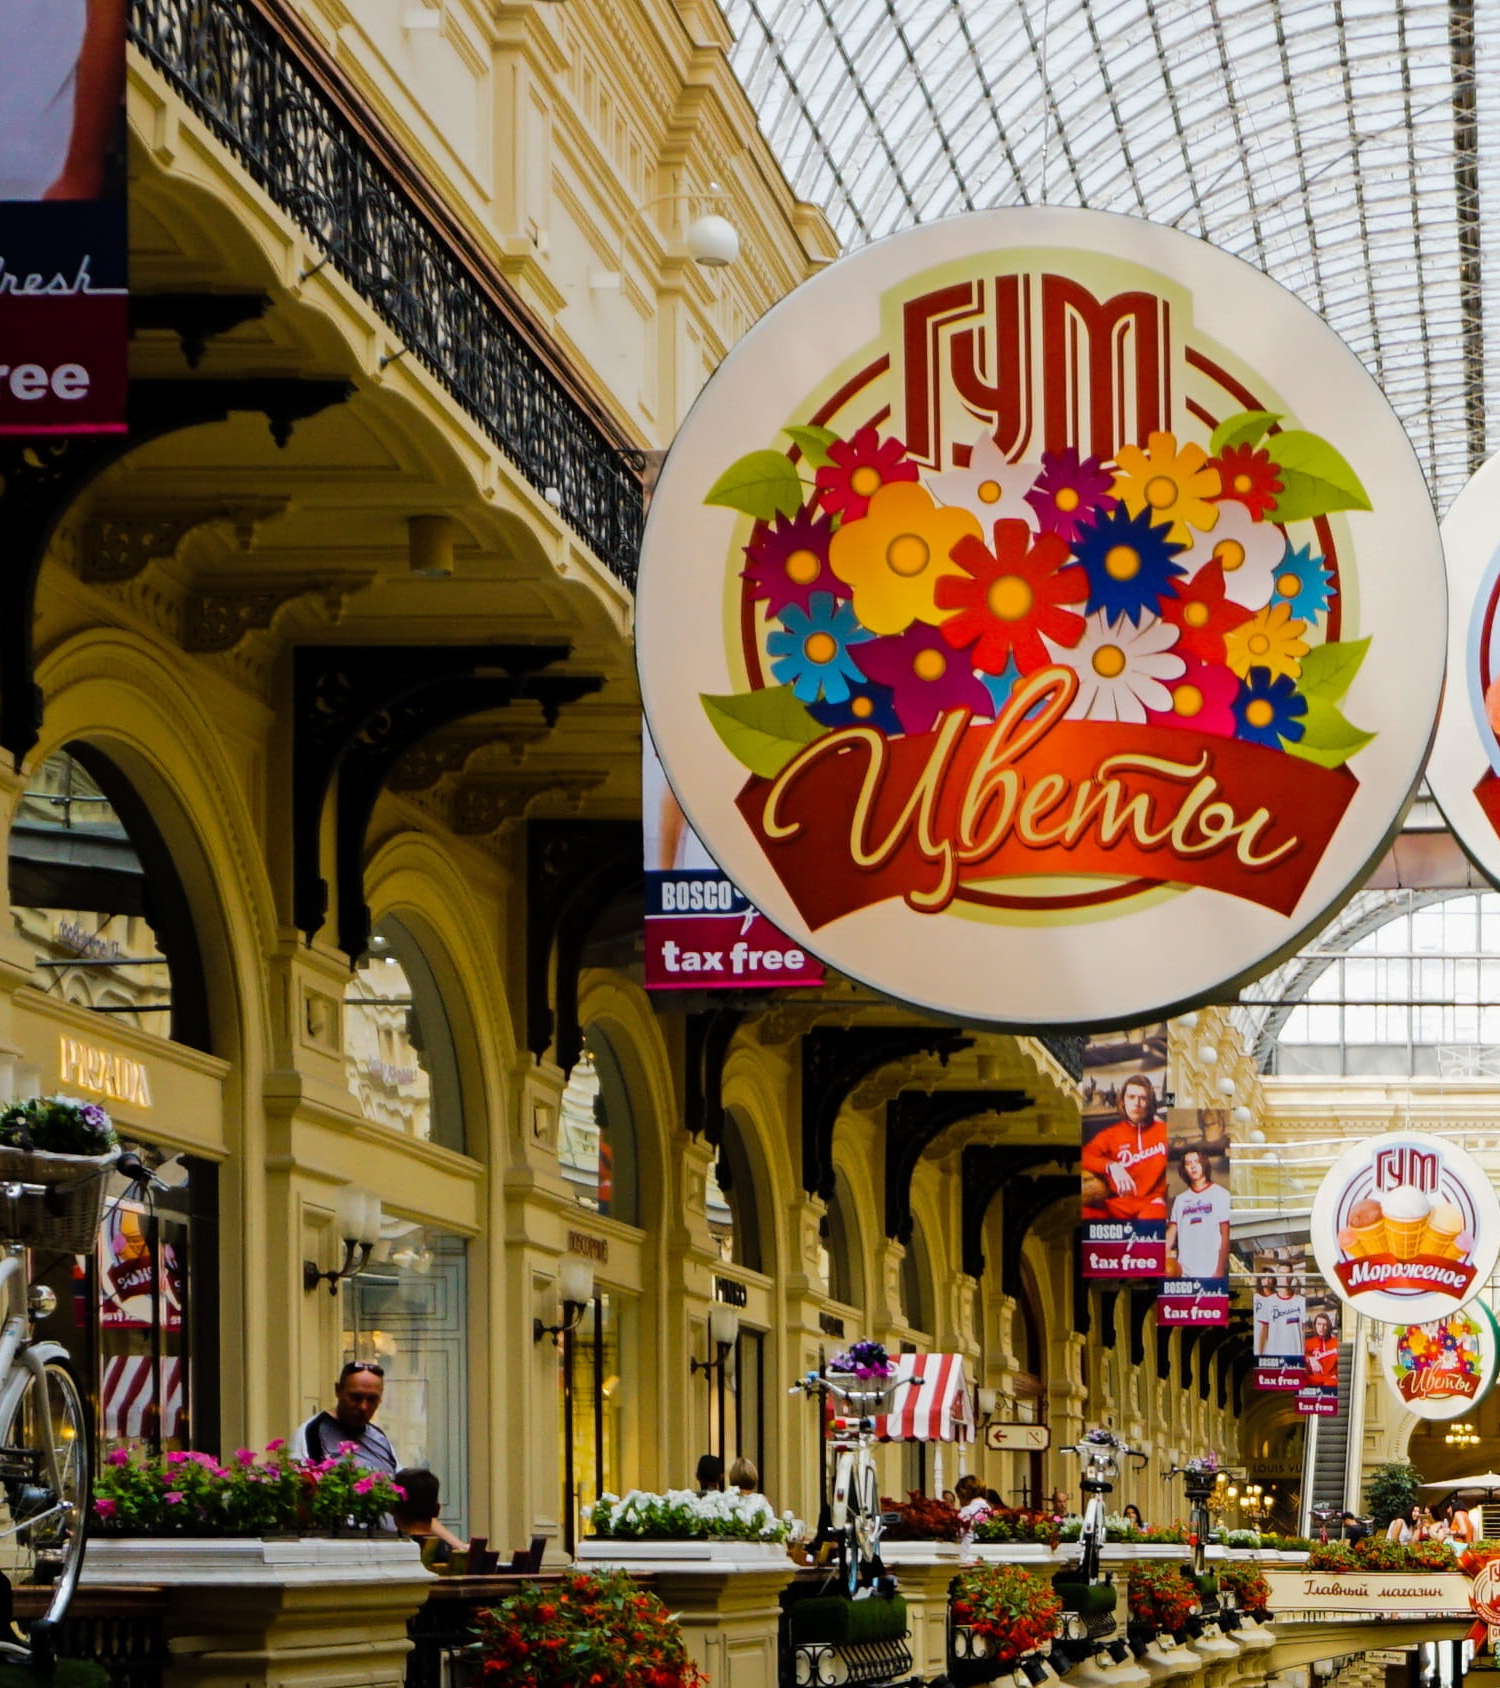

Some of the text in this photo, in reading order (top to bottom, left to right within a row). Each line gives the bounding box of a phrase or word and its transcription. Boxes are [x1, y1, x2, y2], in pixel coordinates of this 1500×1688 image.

[904, 272, 1171, 468] ГУМ
[762, 666, 1298, 913] Цветы
[662, 881, 732, 911] BOSCO
[662, 940, 805, 974] tax free
[59, 1034, 153, 1109] PRADA
[1376, 1148, 1439, 1193] ГУМ
[1089, 1224, 1159, 1251] BOSCO fresh
[1089, 1253, 1157, 1270] tax free
[1348, 1261, 1467, 1288] Мороженое
[1163, 1281, 1194, 1294] BOSCO
[1163, 1306, 1221, 1319] tax free
[1258, 1375, 1300, 1385] tax free
[1400, 1359, 1474, 1399] Цветы
[1302, 1578, 1443, 1599] Главный магазин
